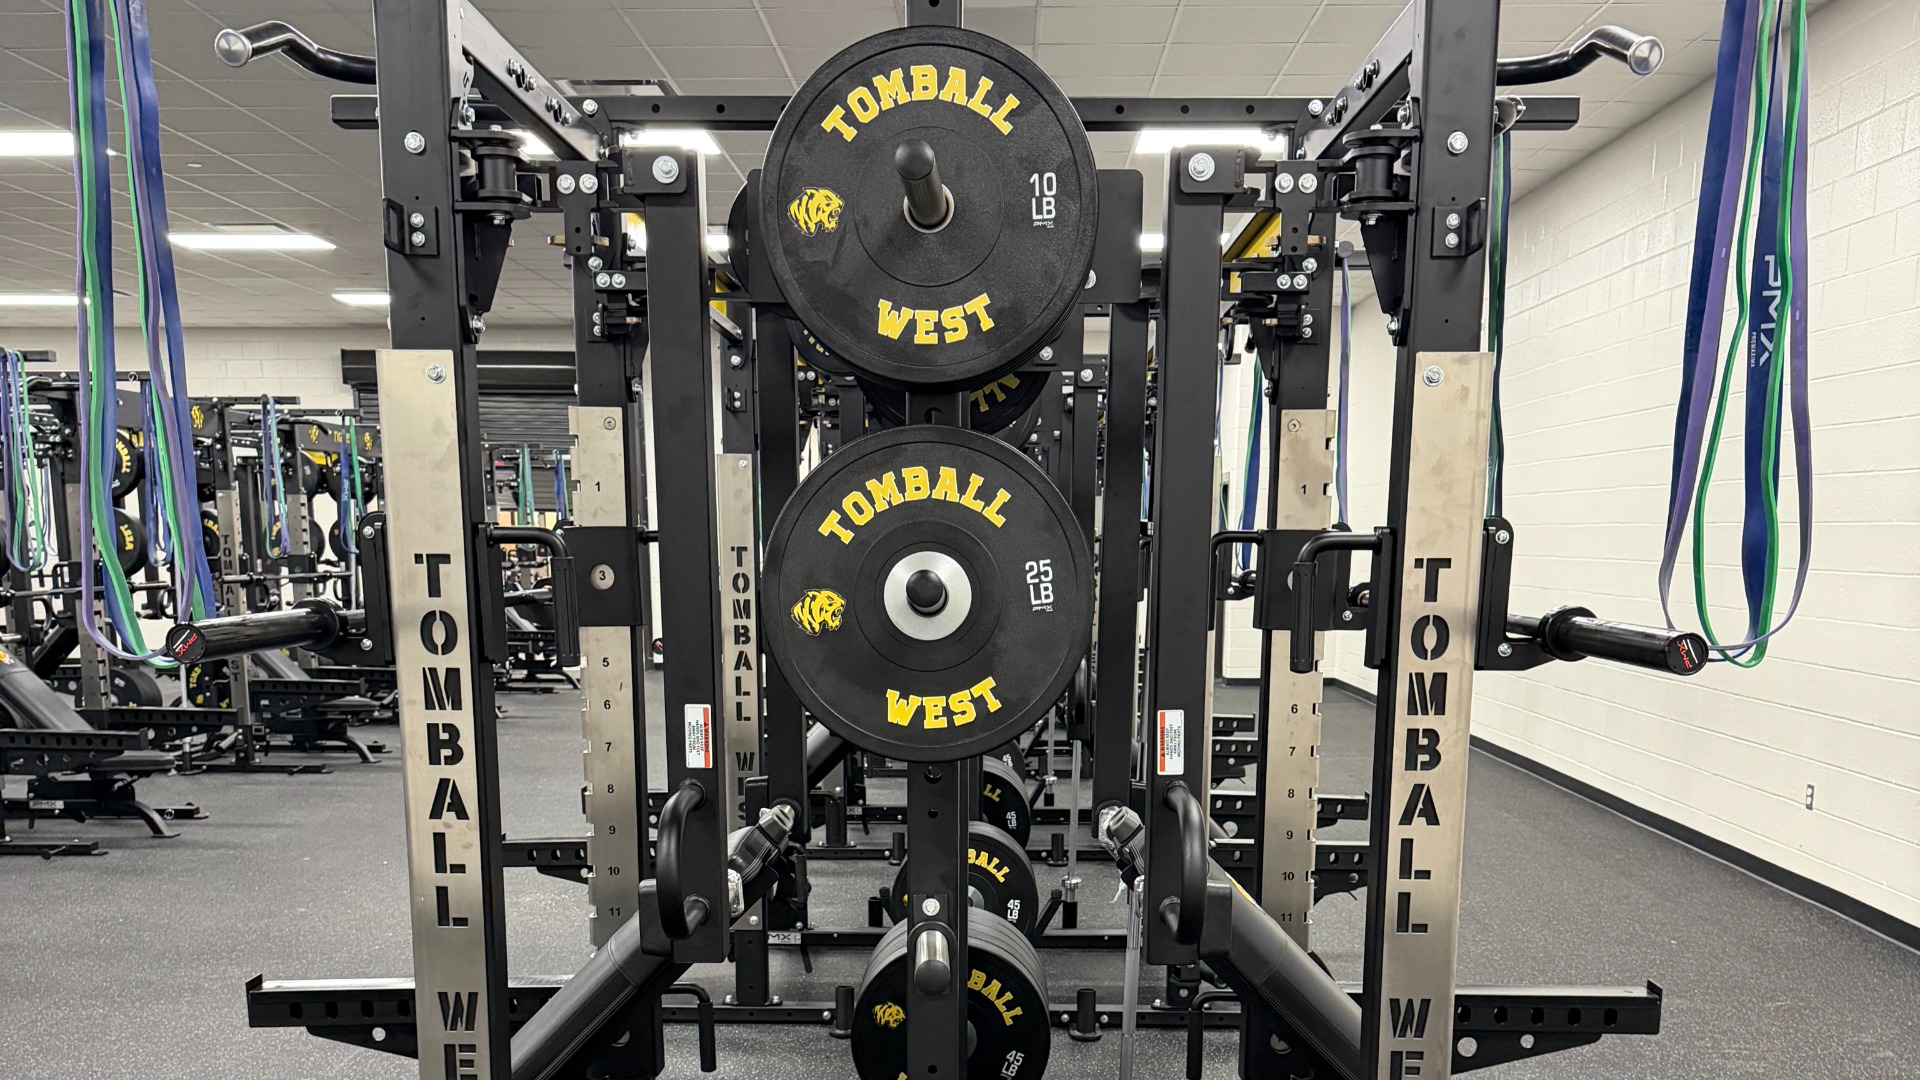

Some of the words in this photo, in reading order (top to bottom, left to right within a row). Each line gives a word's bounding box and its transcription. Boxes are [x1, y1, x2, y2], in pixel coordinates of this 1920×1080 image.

[821, 65, 1020, 142] TOMBALL
[1030, 172, 1057, 196] 10
[1032, 197, 1056, 220] LB
[1760, 255, 1782, 367] PMX
[878, 293, 995, 345] WEST
[595, 482, 601, 491] 1
[1301, 484, 1307, 494] 1
[818, 465, 1011, 545] TOMBALL
[221, 534, 235, 617] TOMAL
[599, 570, 606, 581] 3
[1025, 559, 1053, 584] 25
[1030, 583, 1054, 605] LB
[731, 546, 753, 722] TOMBALL
[179, 633, 197, 657] PMX
[1677, 641, 1693, 669] PMX
[602, 658, 609, 667] 5
[604, 700, 611, 709] 6
[886, 677, 1002, 729] WEST
[1291, 704, 1298, 713] 6
[414, 553, 470, 927] TOMBALL
[1395, 557, 1452, 934] TOMBALL
[605, 742, 612, 752] 7
[1289, 746, 1296, 756] 7
[607, 784, 614, 794] 8
[1288, 788, 1295, 798] 8
[1006, 811, 1017, 820] 45
[1008, 819, 1017, 827] LB
[609, 825, 616, 835] 9
[1286, 830, 1293, 840] 9
[608, 866, 620, 876] 10
[968, 848, 1010, 883] BALL
[1282, 871, 1295, 881] 10
[1007, 899, 1021, 910] 45
[609, 907, 621, 917] 11
[1007, 910, 1019, 919] LB
[1281, 912, 1292, 922] 11
[967, 969, 1023, 1026] BALL
[1006, 1050, 1024, 1066] 45
[1002, 1062, 1018, 1077] LB
